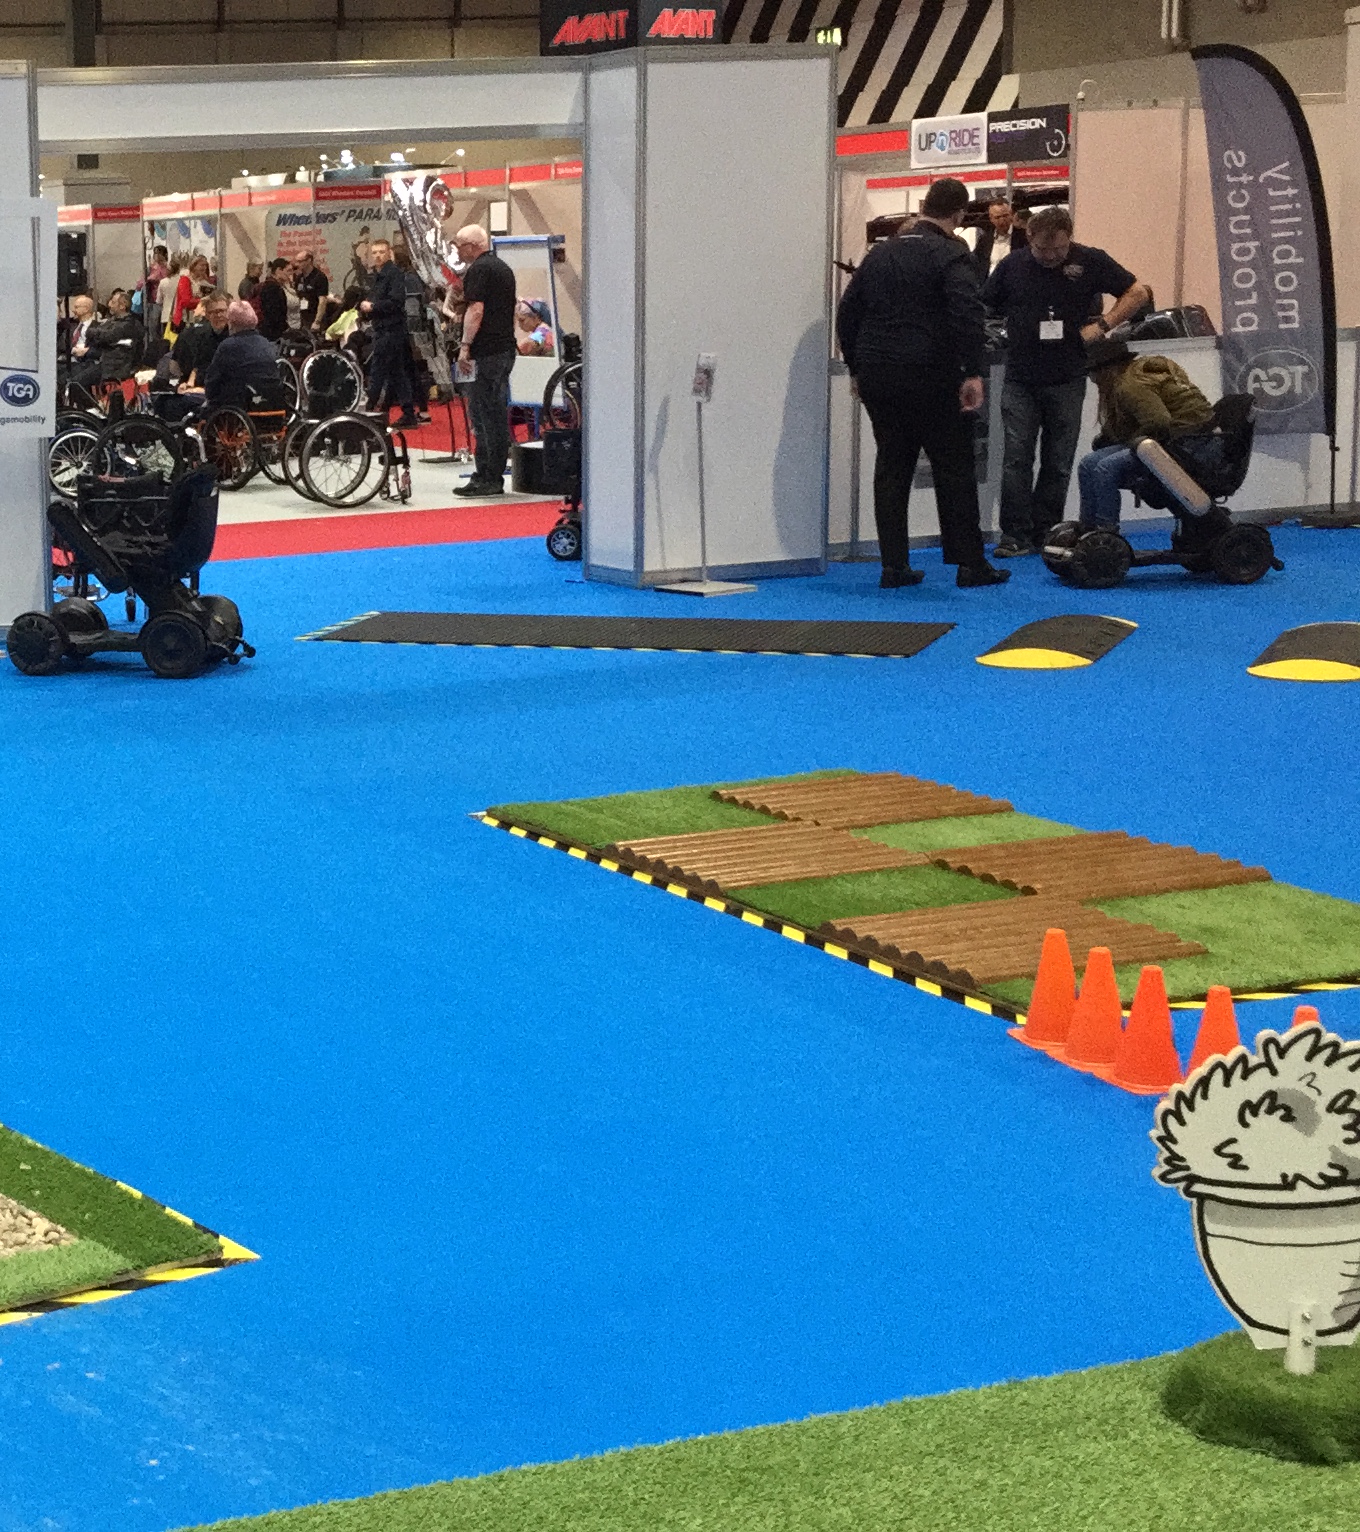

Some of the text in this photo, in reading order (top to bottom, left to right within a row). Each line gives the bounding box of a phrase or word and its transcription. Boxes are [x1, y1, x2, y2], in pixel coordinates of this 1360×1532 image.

[549, 9, 629, 47] AVANT
[646, 8, 716, 38] AVANT
[989, 118, 1047, 133] PRECISION
[6, 382, 34, 399] TGA
